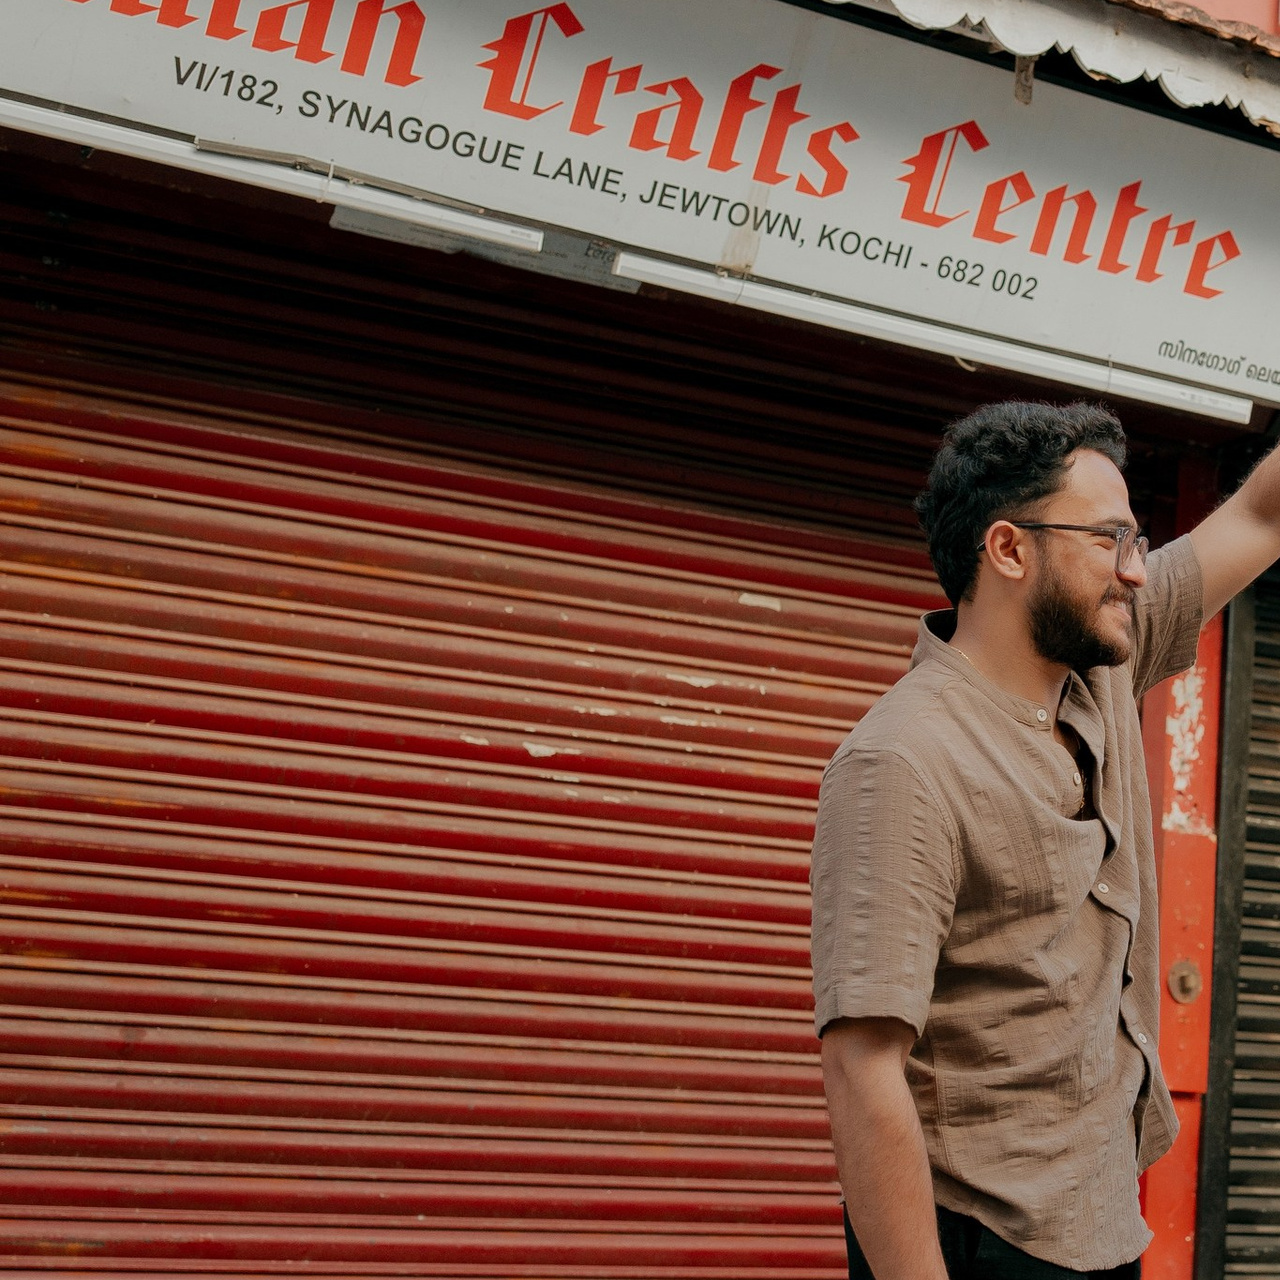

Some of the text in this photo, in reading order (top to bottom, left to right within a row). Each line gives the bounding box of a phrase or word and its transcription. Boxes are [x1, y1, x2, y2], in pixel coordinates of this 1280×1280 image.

[173, 56, 284, 115] VI/182,
[298, 89, 526, 171] SYNAGOGUE
[532, 150, 628, 202] LANE,
[639, 179, 805, 248] JEWTOWN,
[817, 224, 913, 270] KOCHI
[937, 255, 986, 288] 682
[992, 269, 1039, 301] 002
[475, 1, 861, 199] Crafts
[894, 120, 1241, 300] Centre
